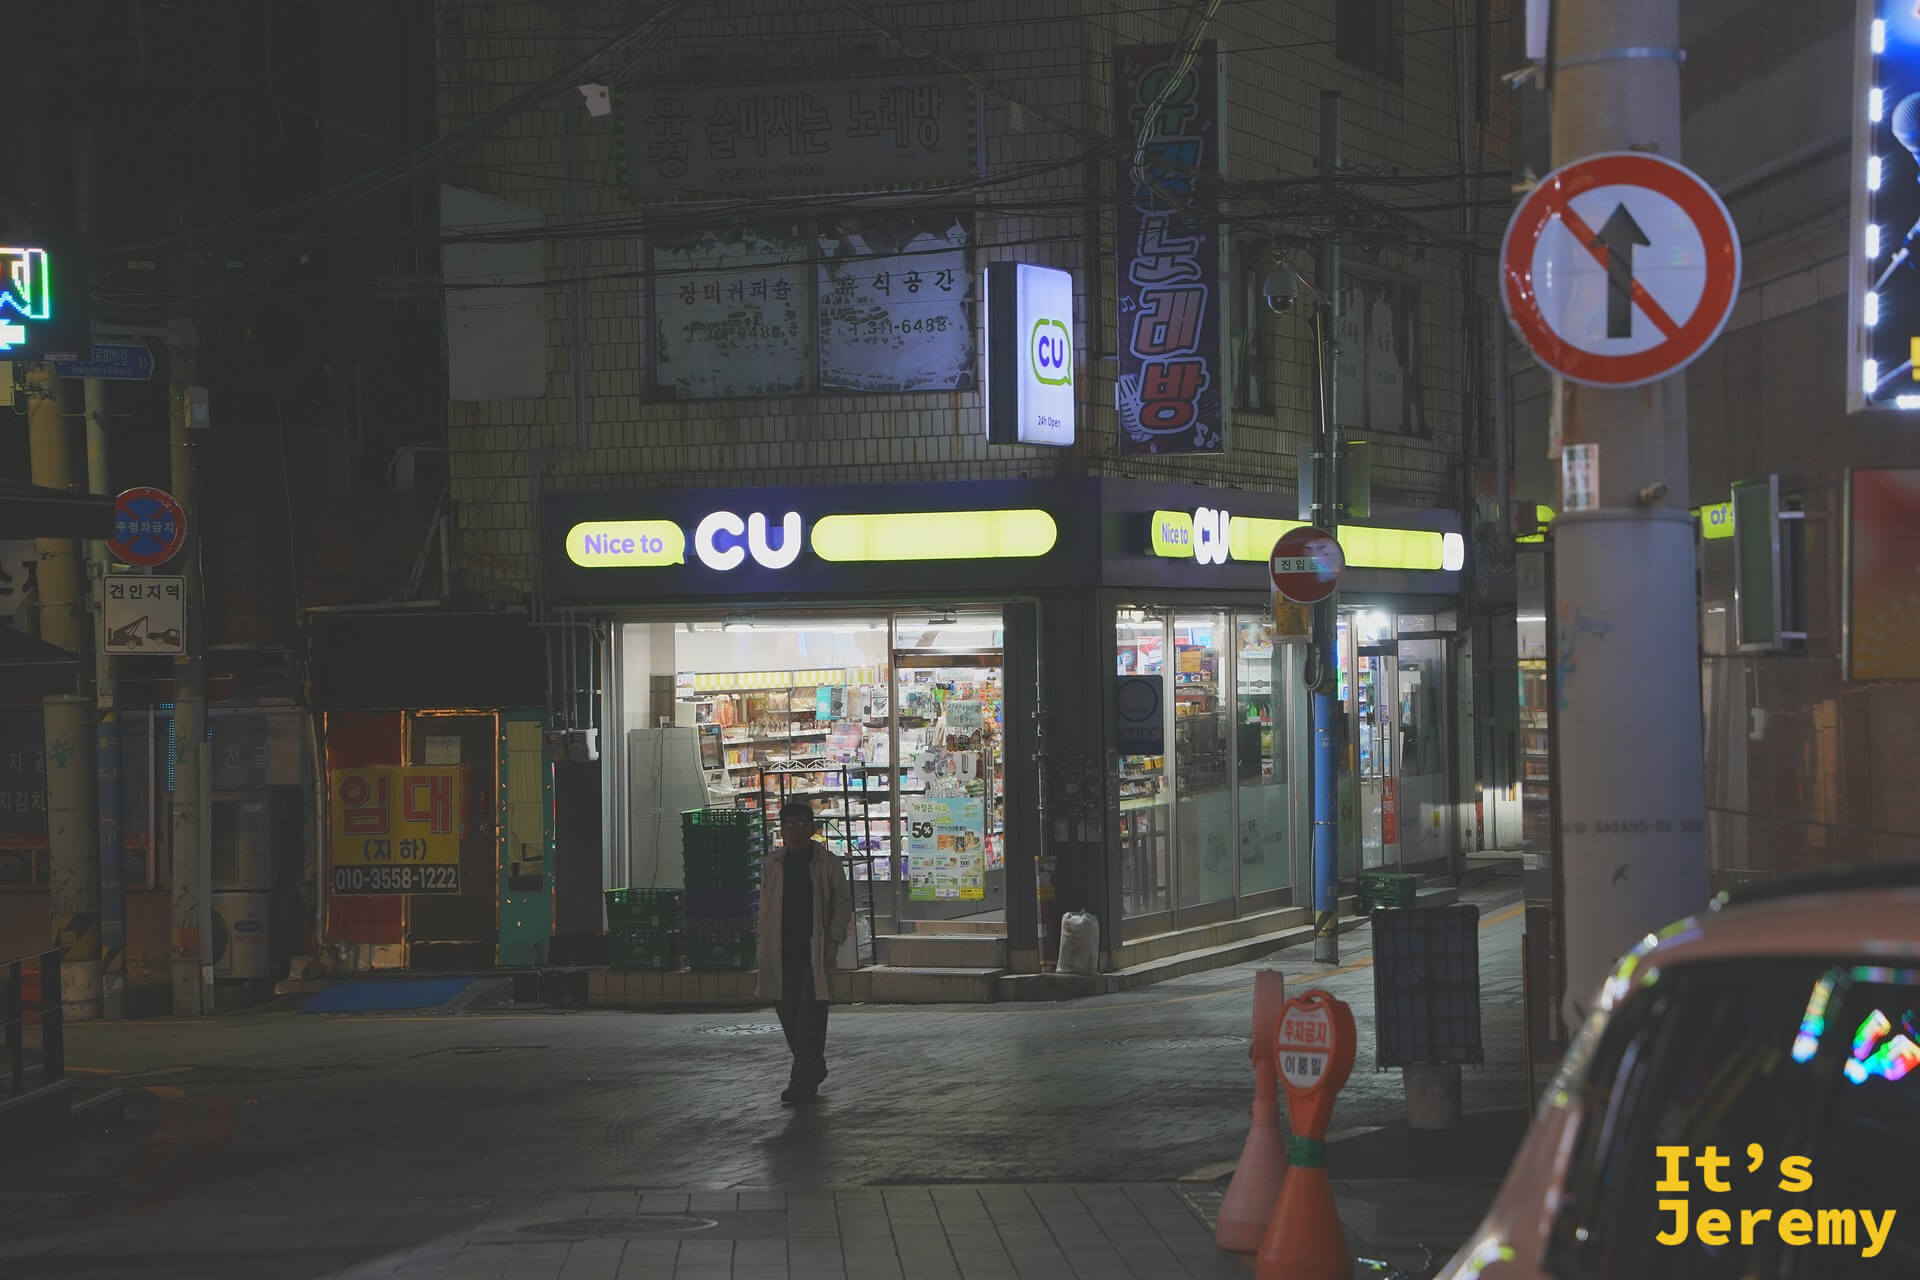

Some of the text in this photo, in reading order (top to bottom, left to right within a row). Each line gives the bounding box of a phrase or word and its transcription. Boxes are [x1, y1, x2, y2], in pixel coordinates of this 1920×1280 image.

[706, 84, 946, 160] 술마시는 노래방
[1038, 334, 1064, 368] CU
[115, 519, 175, 536] 주정차금지
[584, 511, 803, 571] Nice to CU
[1160, 506, 1230, 565] Nice to CU
[109, 583, 180, 600] 견인지역
[339, 775, 453, 836] 임대
[336, 866, 457, 891] 010-3558-1222
[1285, 1019, 1328, 1043] 주차금지
